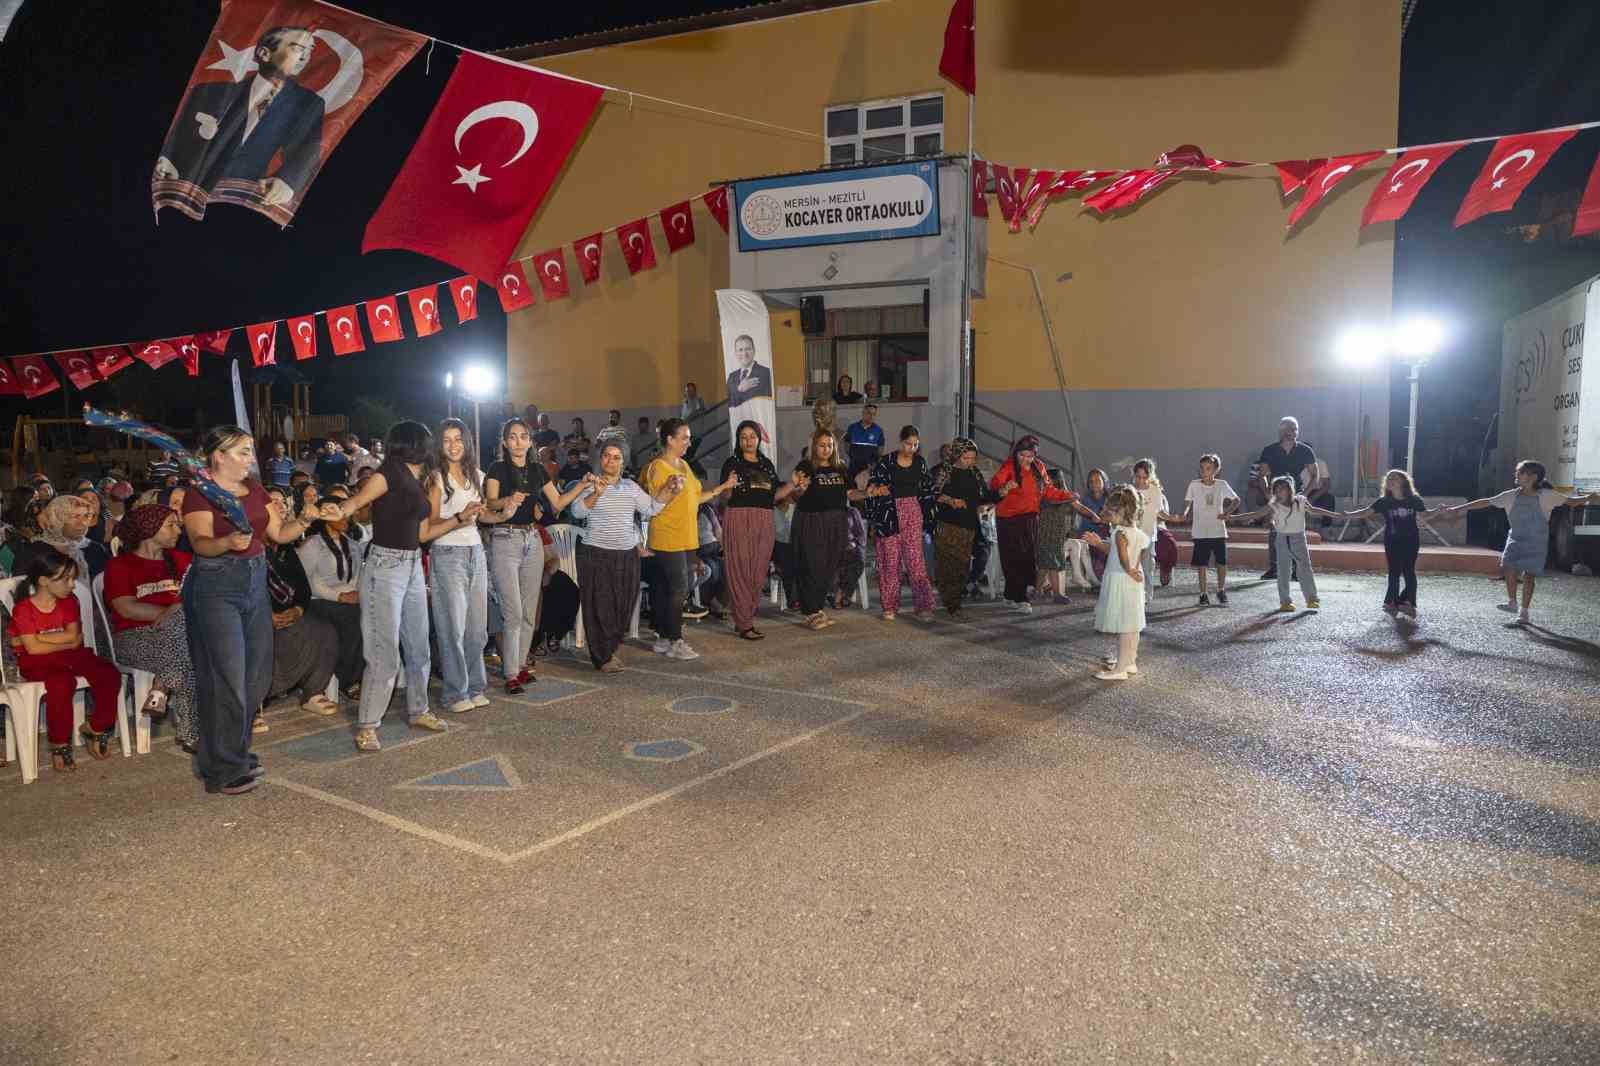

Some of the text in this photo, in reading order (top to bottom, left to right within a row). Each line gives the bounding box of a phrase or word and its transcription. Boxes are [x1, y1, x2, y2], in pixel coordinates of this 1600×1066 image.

[784, 194, 820, 209] MERSİN
[828, 190, 866, 204] MEZİTLİ
[785, 199, 924, 228] KOCAYER ORTAOKULU
